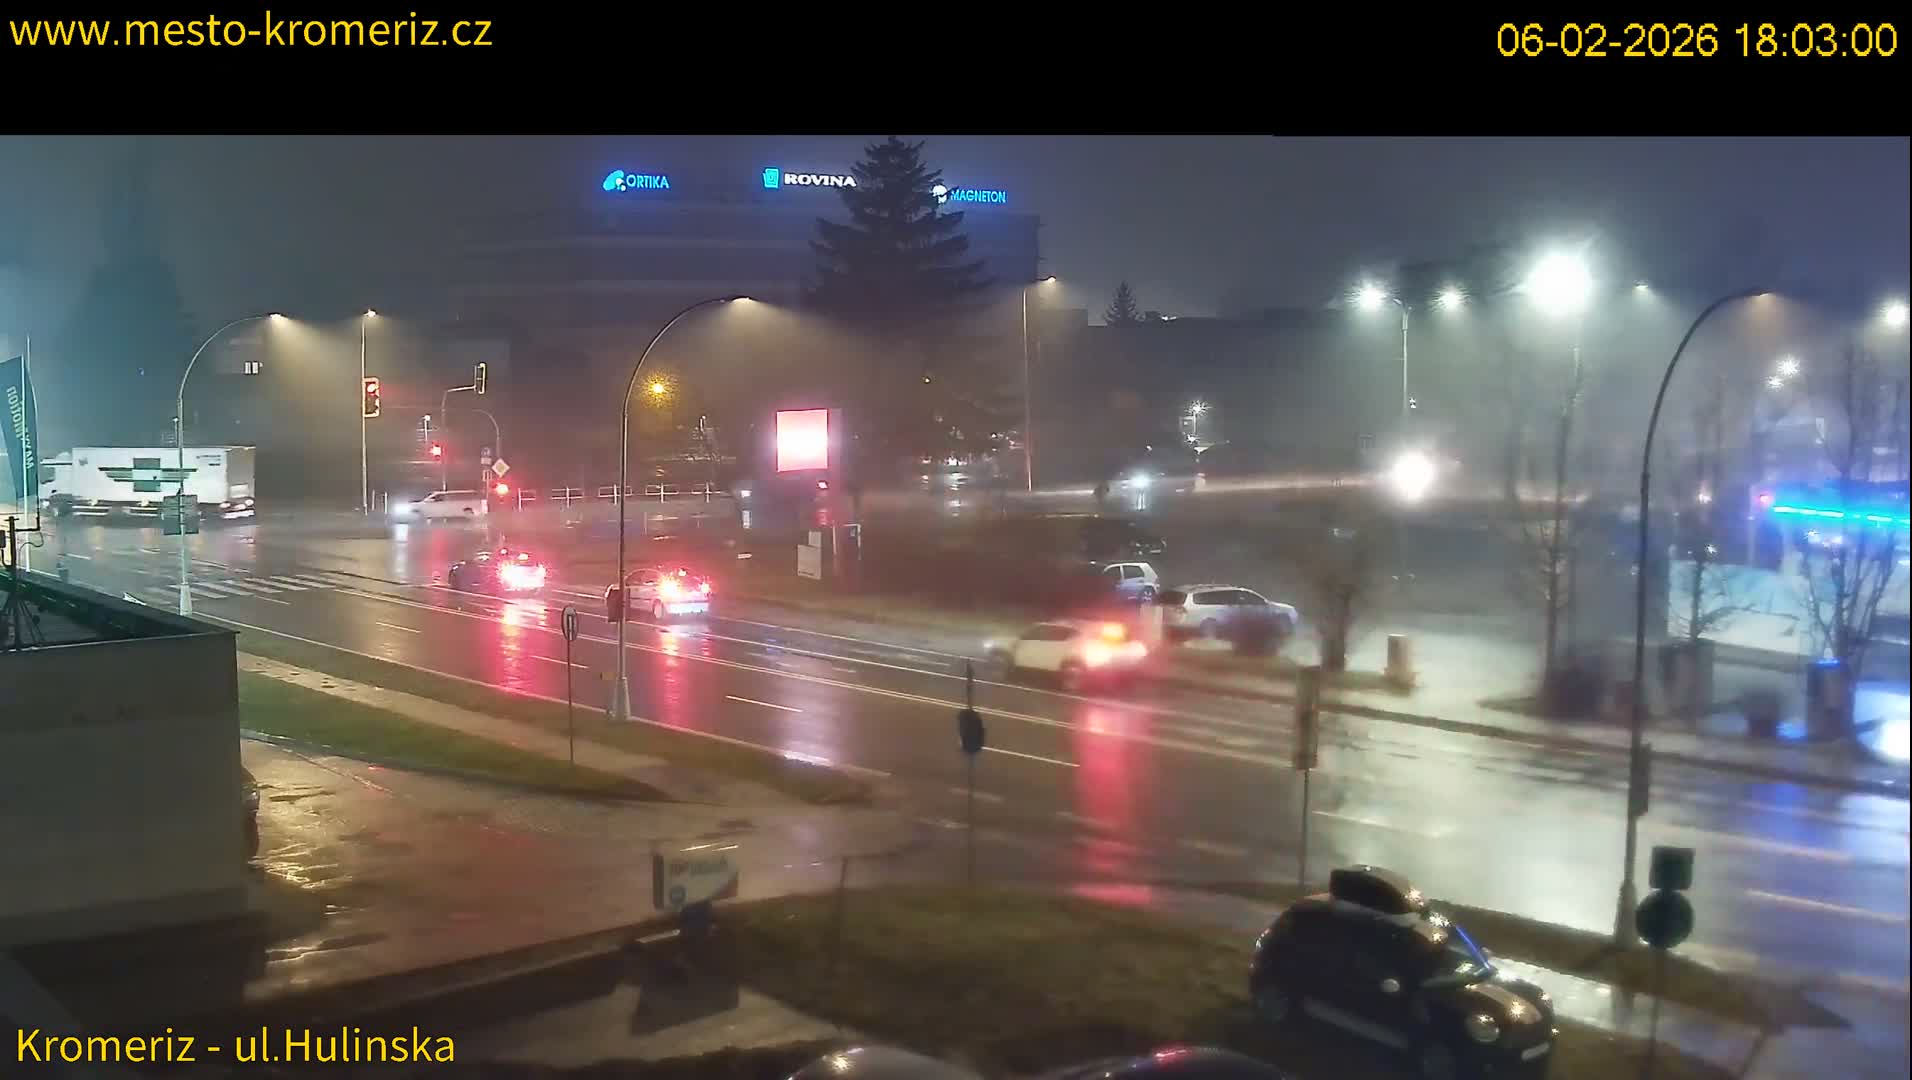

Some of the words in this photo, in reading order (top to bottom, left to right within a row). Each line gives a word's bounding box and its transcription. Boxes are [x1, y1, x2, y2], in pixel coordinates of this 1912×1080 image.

[626, 174, 670, 189] ORTIKA
[784, 173, 857, 187] ROVINA
[950, 188, 1007, 203] MAGNETON
